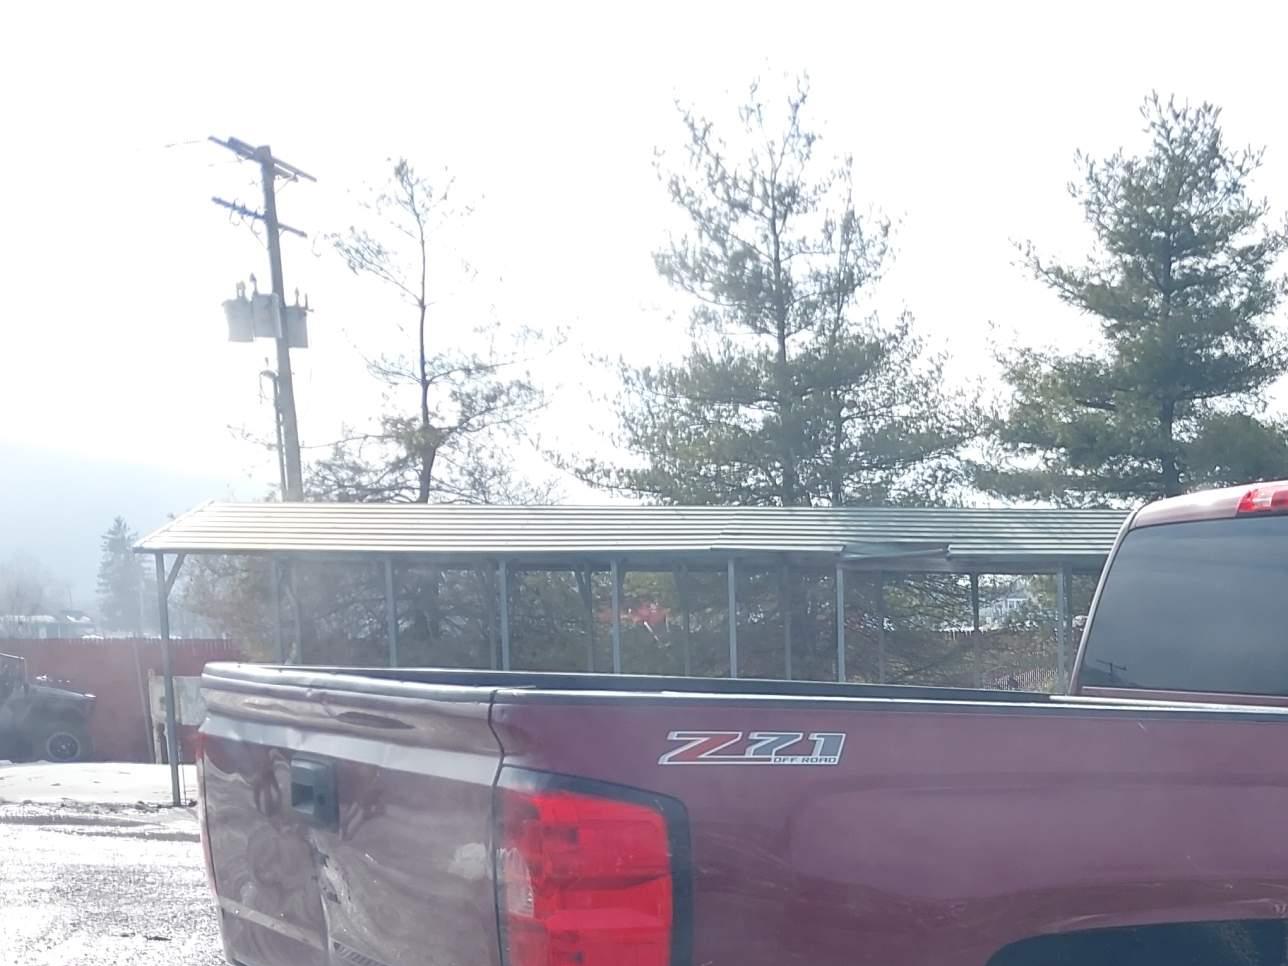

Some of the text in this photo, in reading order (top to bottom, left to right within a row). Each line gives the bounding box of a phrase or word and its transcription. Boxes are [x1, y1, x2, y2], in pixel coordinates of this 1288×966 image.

[658, 731, 846, 765] Z71
[773, 756, 838, 764] OFF ROAD
